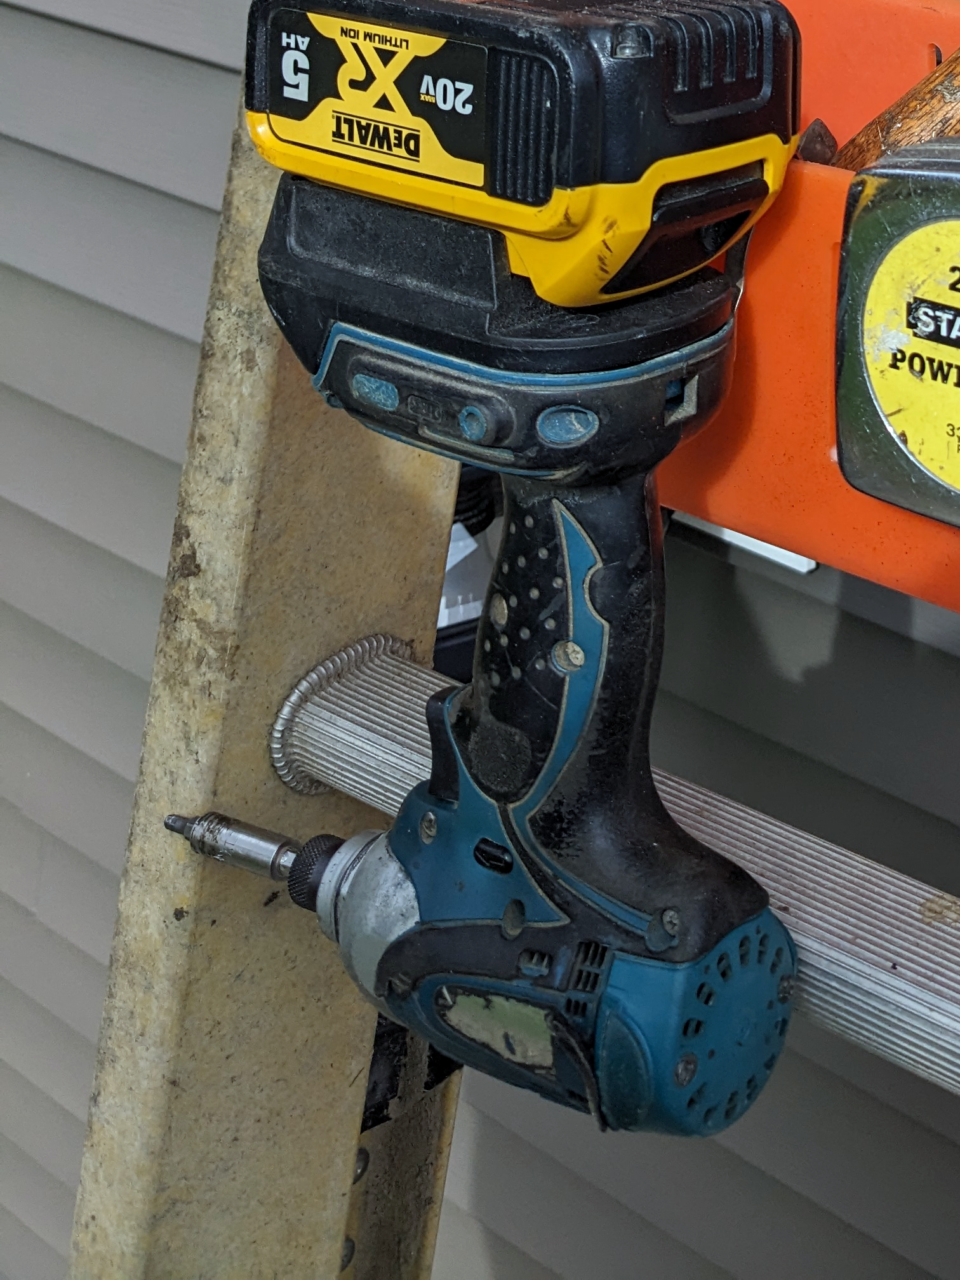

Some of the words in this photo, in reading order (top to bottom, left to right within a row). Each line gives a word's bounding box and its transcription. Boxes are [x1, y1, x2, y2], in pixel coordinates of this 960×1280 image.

[340, 26, 360, 40] ION
[364, 32, 409, 50] LITHIUM
[281, 50, 310, 102] 5
[337, 41, 416, 116] XR
